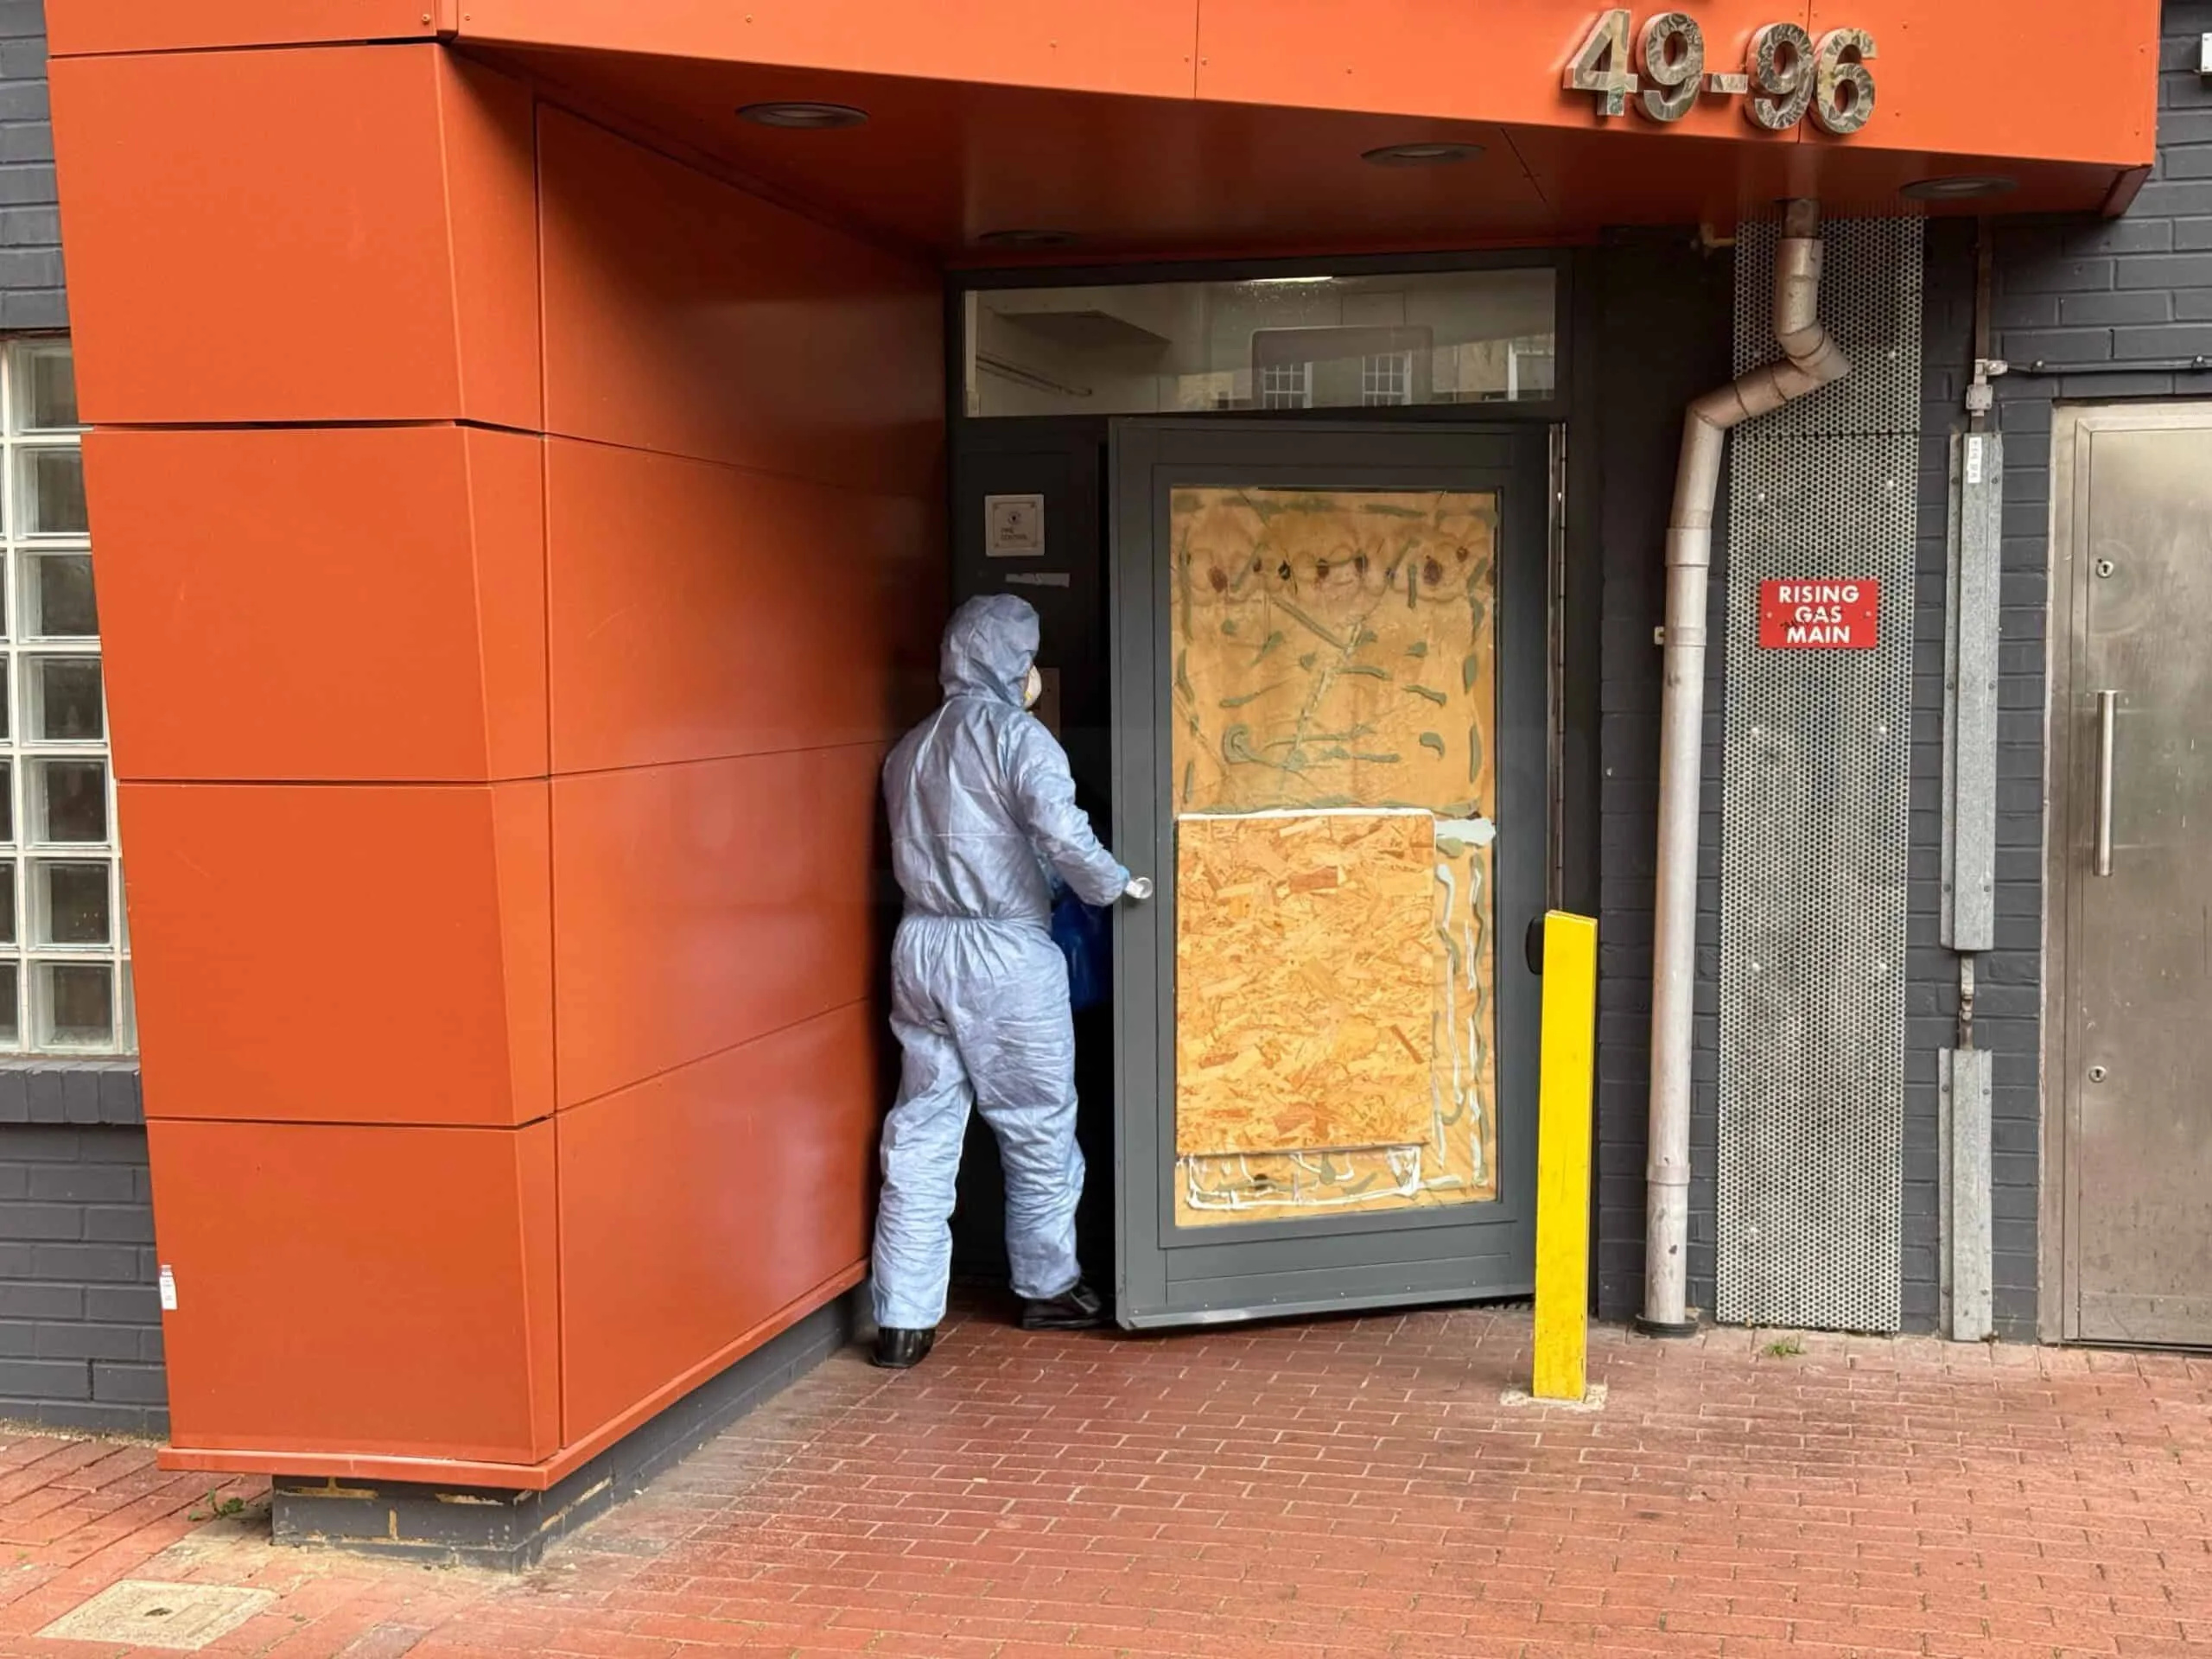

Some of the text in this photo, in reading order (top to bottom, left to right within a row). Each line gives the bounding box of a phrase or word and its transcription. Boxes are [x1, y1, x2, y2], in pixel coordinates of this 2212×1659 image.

[1563, 9, 1878, 134] 49-96
[1778, 585, 1859, 603] RISING
[1795, 606, 1842, 623] GAS
[1787, 626, 1851, 644] MAIN
